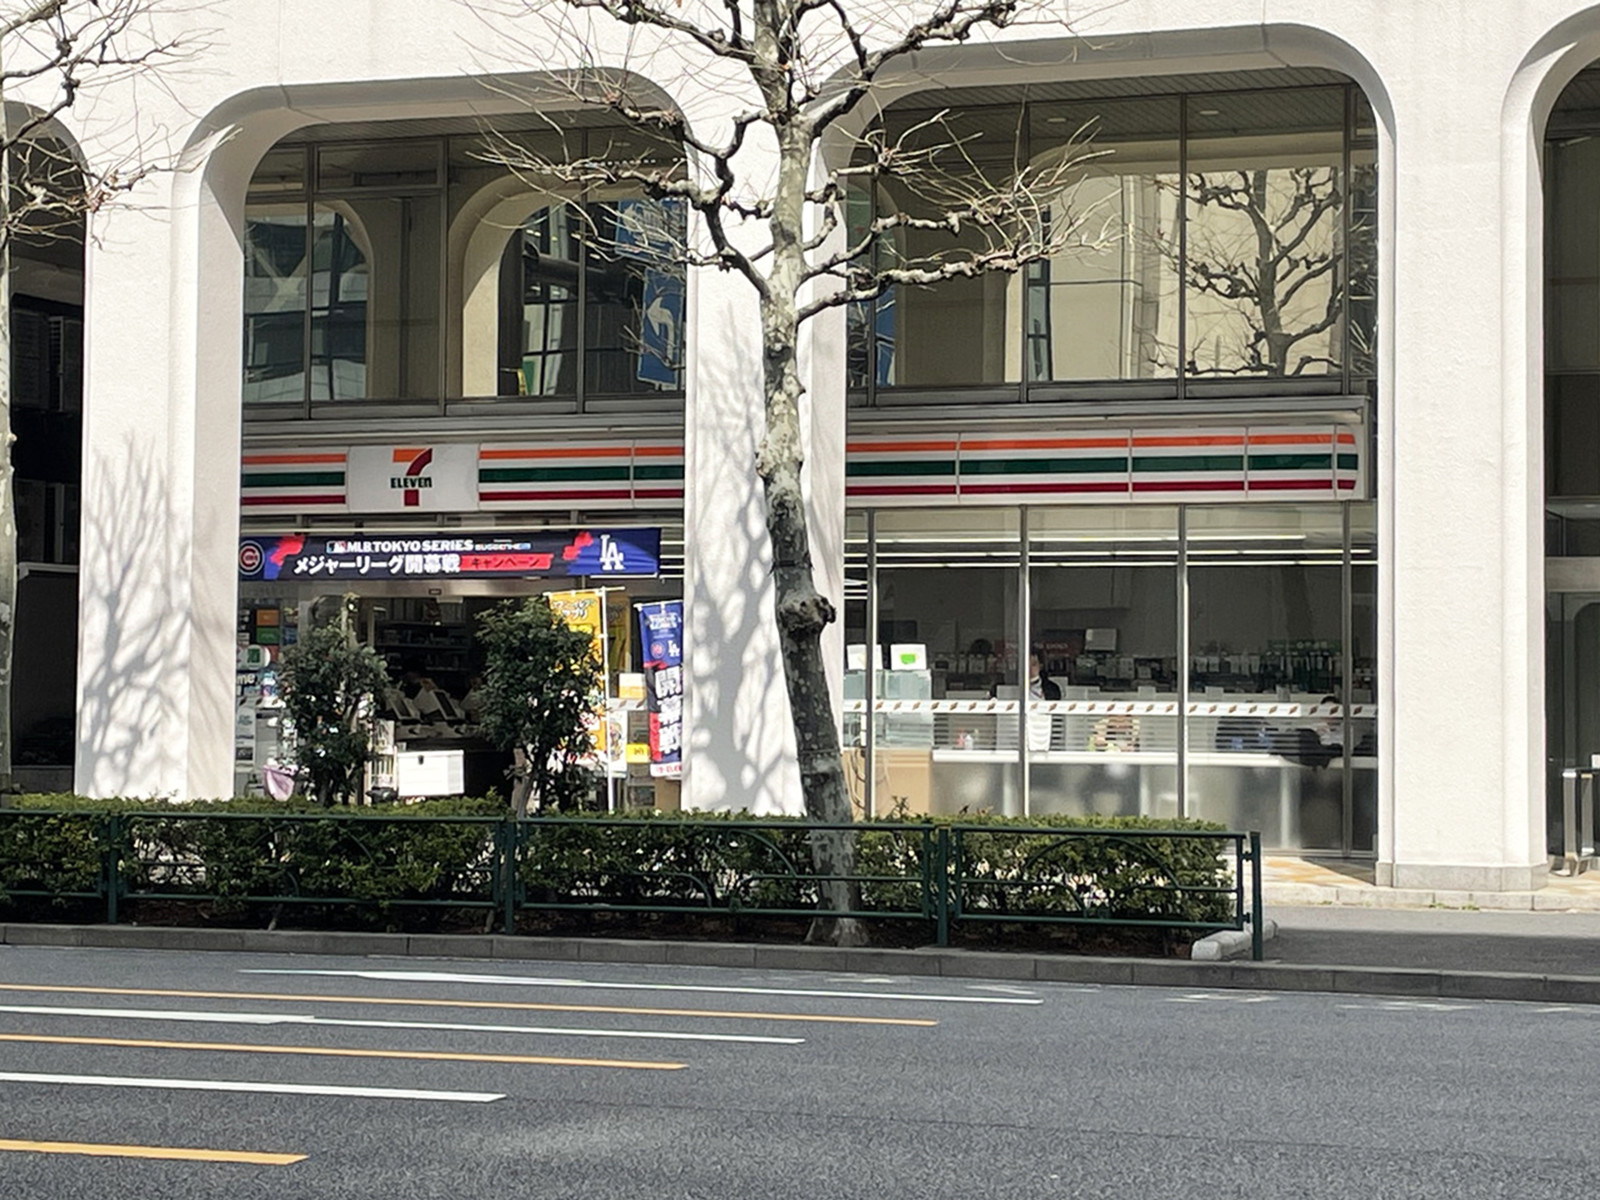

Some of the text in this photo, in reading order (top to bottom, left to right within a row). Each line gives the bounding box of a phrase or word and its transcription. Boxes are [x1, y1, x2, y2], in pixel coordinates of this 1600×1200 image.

[393, 447, 433, 507] 7
[372, 541, 422, 552] TOKYO
[422, 540, 473, 551] SERIES
[599, 534, 625, 570] LA
[293, 554, 461, 575] メジャーリーグ開幕戦
